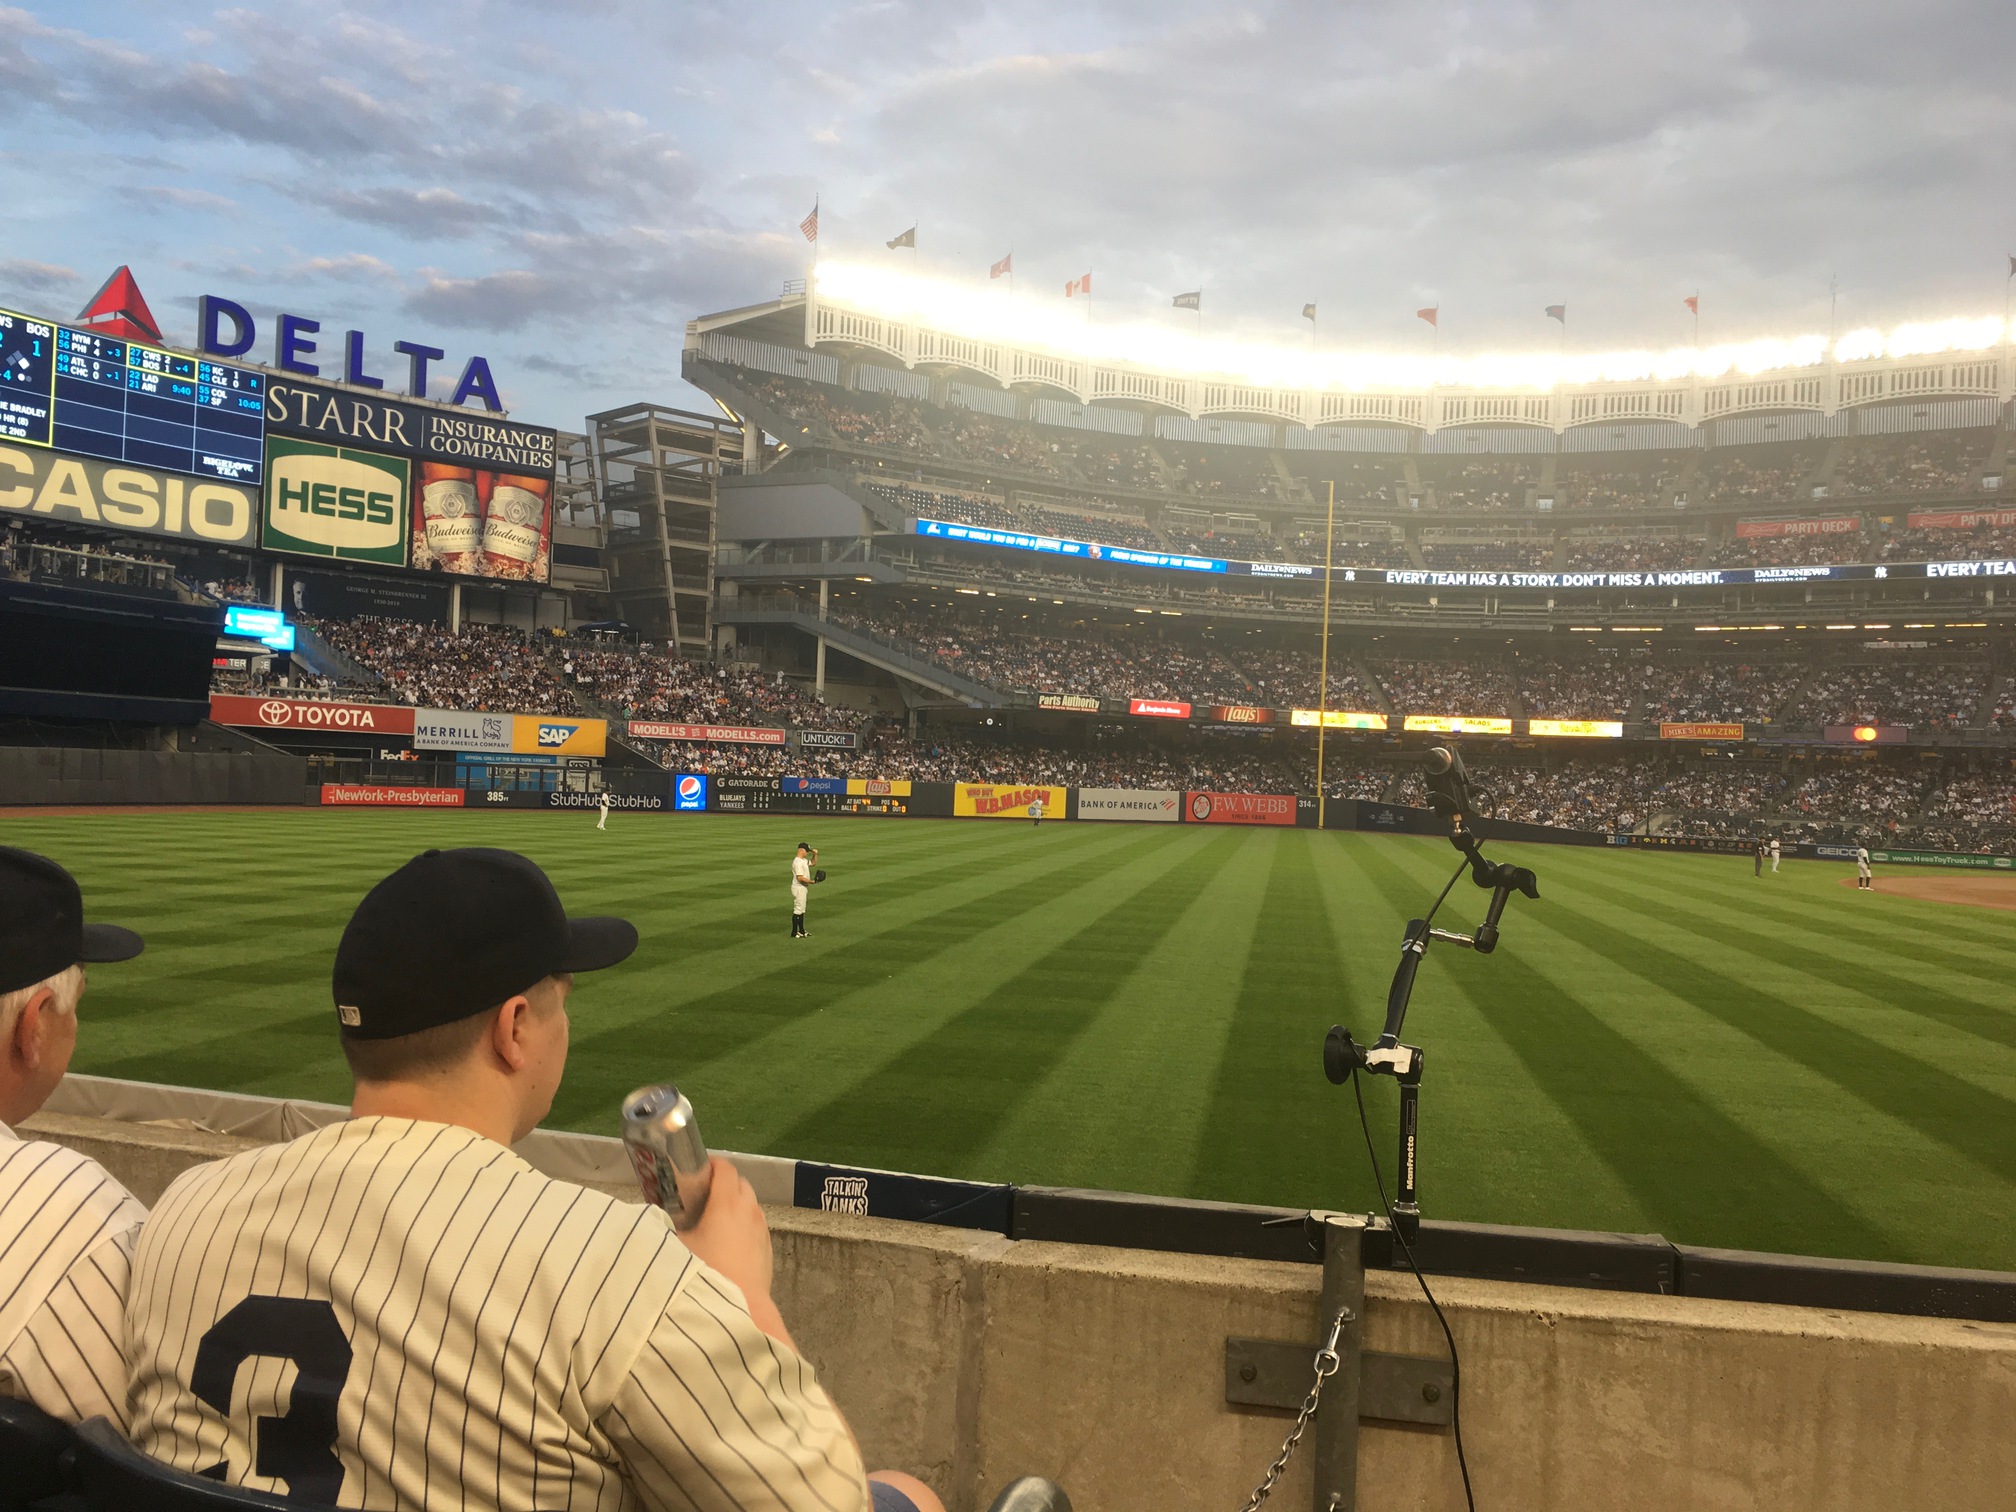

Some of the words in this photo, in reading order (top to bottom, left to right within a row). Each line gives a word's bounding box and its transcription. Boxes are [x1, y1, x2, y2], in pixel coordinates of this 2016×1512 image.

[26, 322, 50, 338] BOS
[58, 330, 70, 340] 32
[72, 333, 91, 345] NYM
[94, 339, 100, 347] 4
[32, 340, 40, 357] 1
[71, 343, 87, 353] PHI
[199, 294, 503, 411] DELTA
[70, 357, 86, 367] ATL
[143, 350, 161, 362] CWS
[165, 355, 170, 364] 2
[70, 366, 88, 377] CHC
[142, 360, 160, 371] BOS
[212, 366, 224, 376] KC
[3, 370, 12, 380] 4
[142, 373, 159, 384] LAD
[211, 376, 228, 386] CLE
[142, 383, 156, 393] ARI
[172, 385, 191, 396] 9:40
[211, 388, 228, 399] COL
[211, 398, 222, 406] SF
[238, 399, 261, 410] 10:05
[10, 403, 46, 418] BRADLEY
[266, 385, 413, 447] STARR
[3, 414, 16, 423] HR
[9, 426, 26, 437] 2ND
[430, 416, 554, 452] INSURANCE
[430, 435, 553, 470] COMPANIES
[217, 466, 239, 477] TEA
[0, 444, 249, 540] CASIO
[279, 477, 394, 526] HESS
[1961, 513, 1998, 526] PARTY
[1785, 522, 1819, 533] PARTY
[1822, 520, 1851, 532] DECK
[486, 523, 538, 547] Budweiser
[1251, 563, 1279, 572] DAILY
[1283, 565, 1312, 575] NEWS
[1754, 569, 1788, 577] DAILY
[1794, 568, 1830, 576] NEWS
[1927, 562, 1978, 577] EVERY
[1984, 561, 2016, 576] TEA
[1386, 571, 1428, 584] EVERY
[1430, 573, 1467, 585] TEAM
[1470, 574, 1497, 586] HAS
[1499, 574, 1510, 586] A
[1512, 574, 1560, 586] STORY.
[1562, 574, 1606, 586] DON'T
[1609, 574, 1642, 586] MISS
[1644, 573, 1655, 586] A
[1658, 572, 1724, 585] MOMENT.
[357, 614, 380, 623] THE
[1039, 696, 1061, 705] Parts
[1062, 695, 1100, 708] Authority
[295, 706, 375, 728] TOYOTA
[417, 726, 478, 738] MERRILL
[539, 728, 569, 743] SAP
[634, 724, 686, 736] MODELL'S
[707, 729, 780, 742] MODELLS.com
[1668, 728, 1692, 736] MIKE'S
[803, 733, 846, 744] UNTUCKit
[380, 749, 420, 761] FedEx
[717, 778, 725, 787] G
[771, 780, 779, 789] G
[810, 782, 830, 790] pepsi
[335, 788, 458, 805] NewYork-Presbyterian
[487, 792, 504, 802] 385
[551, 792, 601, 806] StubHub
[609, 794, 661, 808] StubHub
[1081, 800, 1104, 809] BANK
[1107, 801, 1118, 809] OF
[1120, 801, 1158, 810] AMERICA
[1213, 798, 1237, 812] F.W.
[1242, 798, 1288, 814] WEBB
[1817, 847, 1858, 857] GEICO
[1892, 855, 1988, 865] www.HessToyTruck.com
[828, 1180, 864, 1196] TALKIN'
[825, 1195, 865, 1216] YANKS
